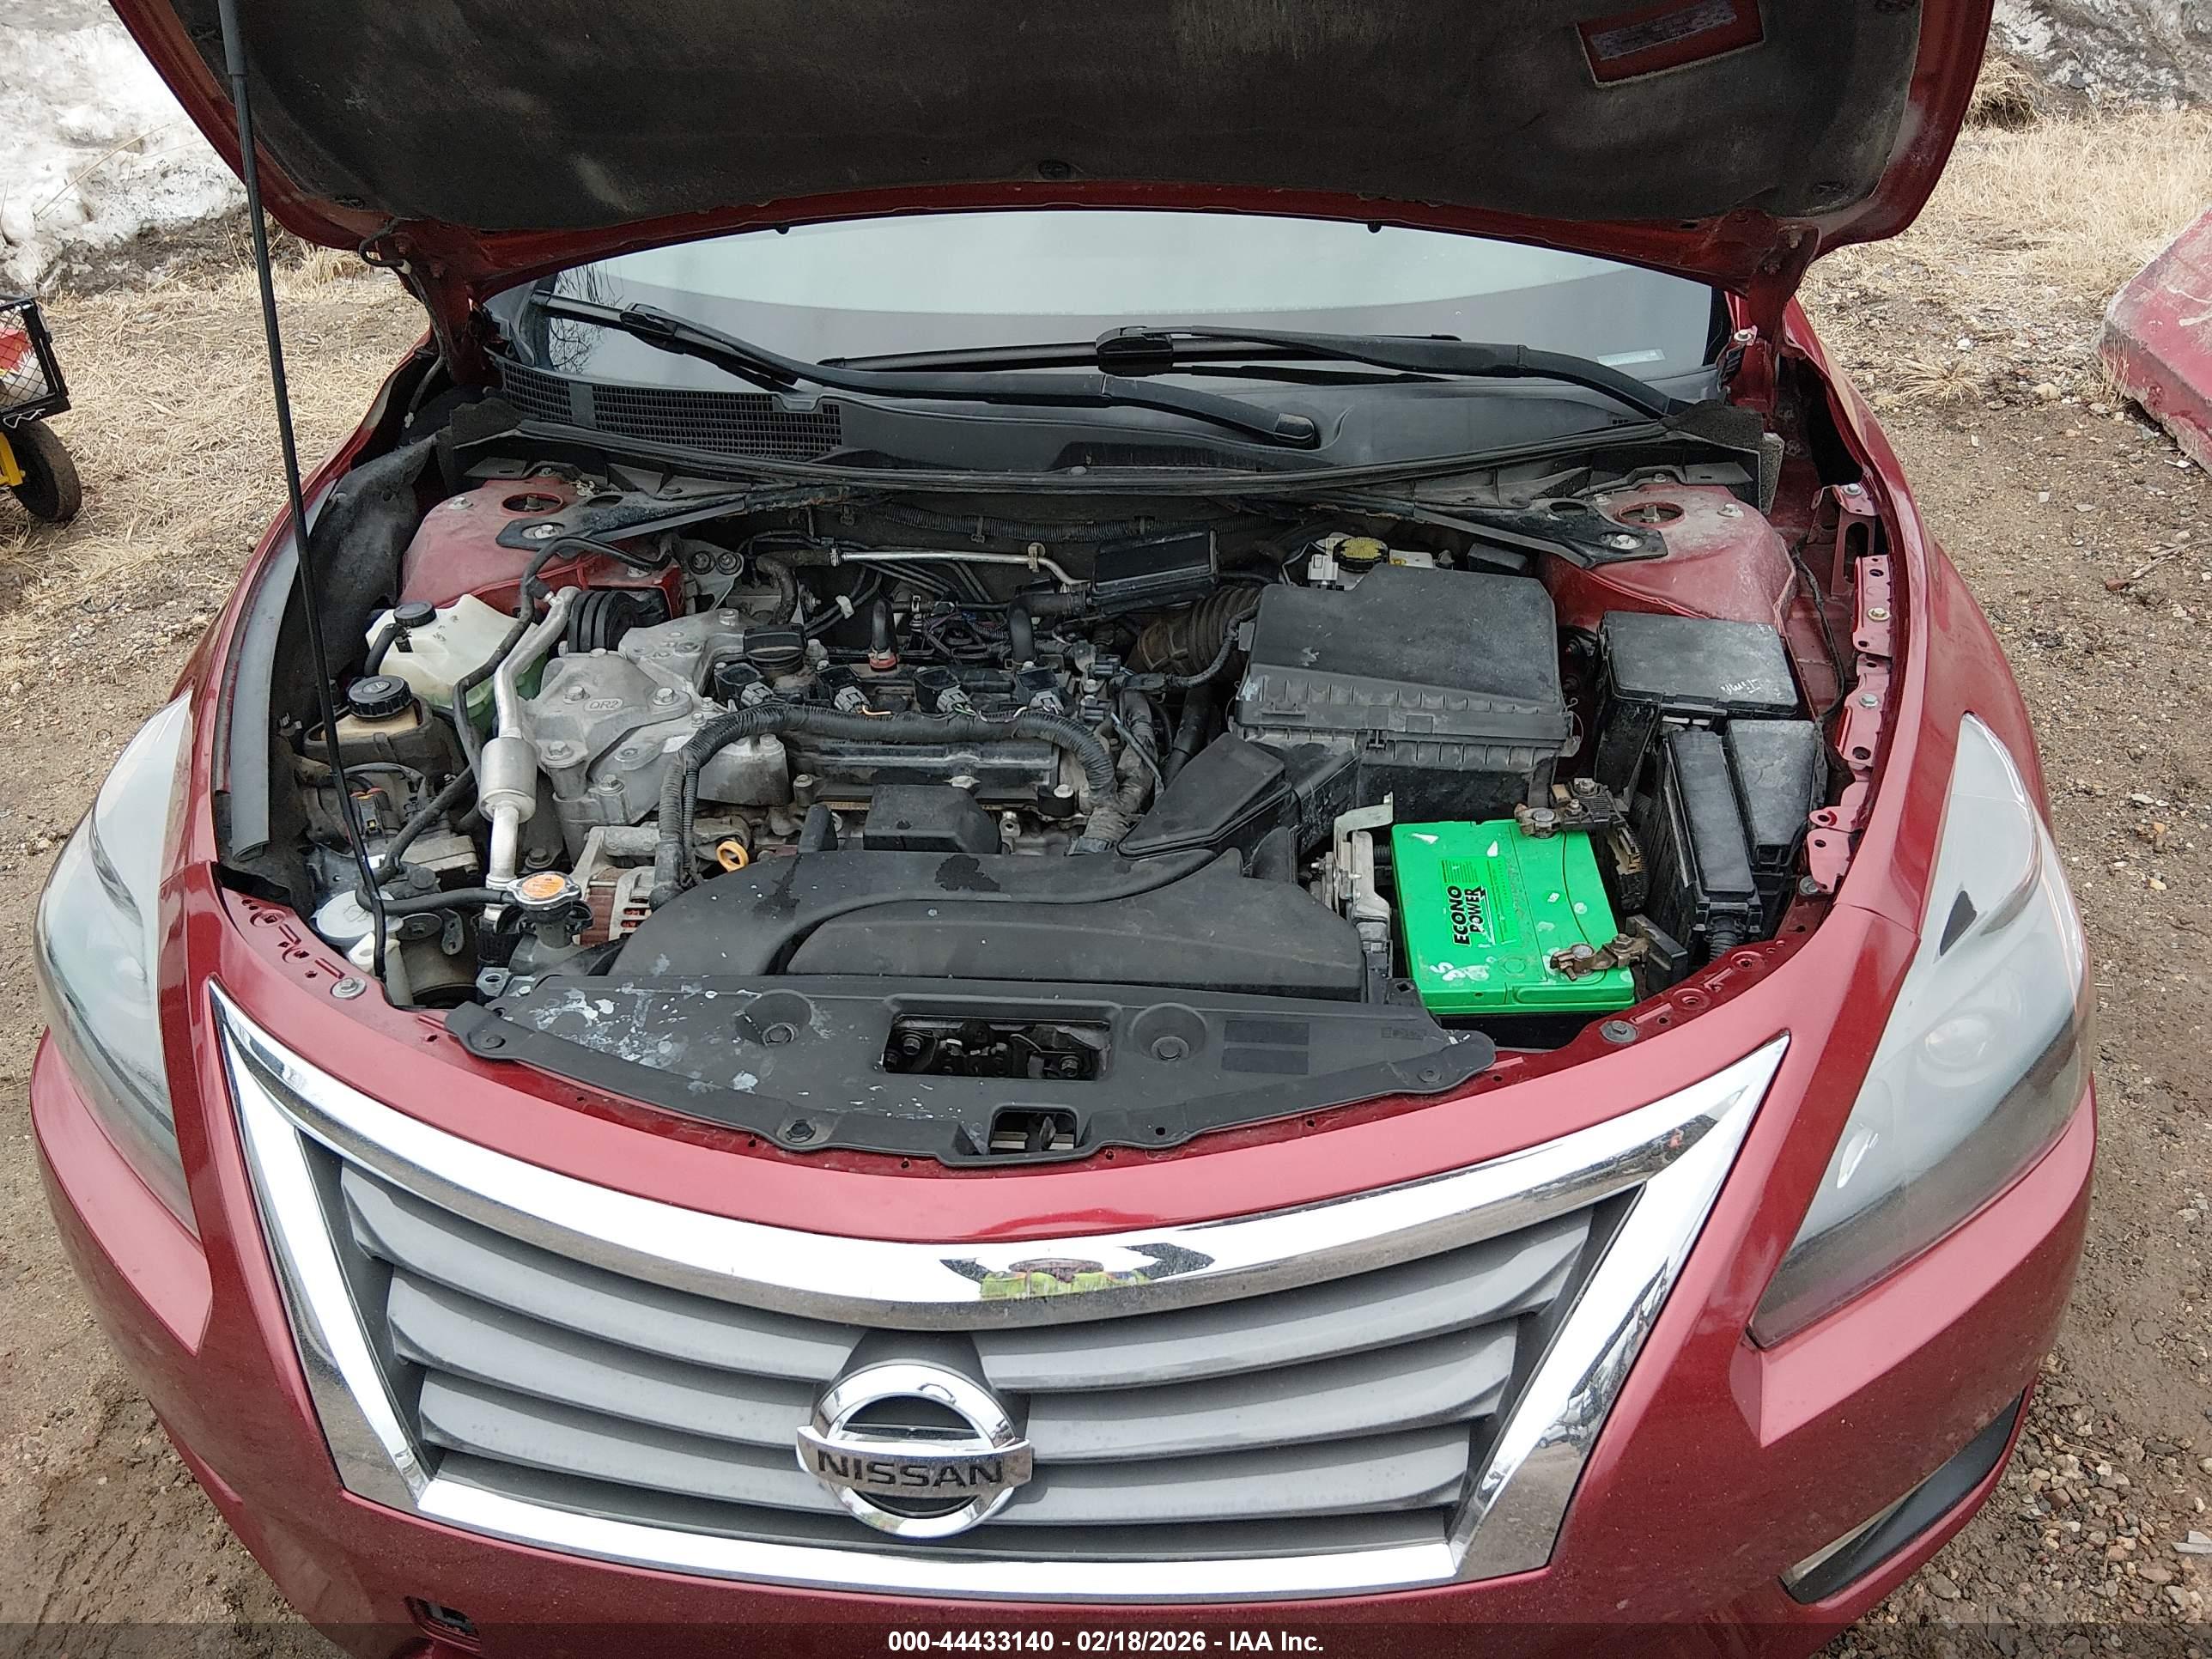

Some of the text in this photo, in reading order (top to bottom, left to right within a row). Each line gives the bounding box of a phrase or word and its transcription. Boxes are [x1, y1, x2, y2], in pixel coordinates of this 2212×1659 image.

[1447, 885, 1471, 945] ECONO
[1464, 885, 1485, 933] POWER
[817, 1449, 1004, 1487] NISSAN
